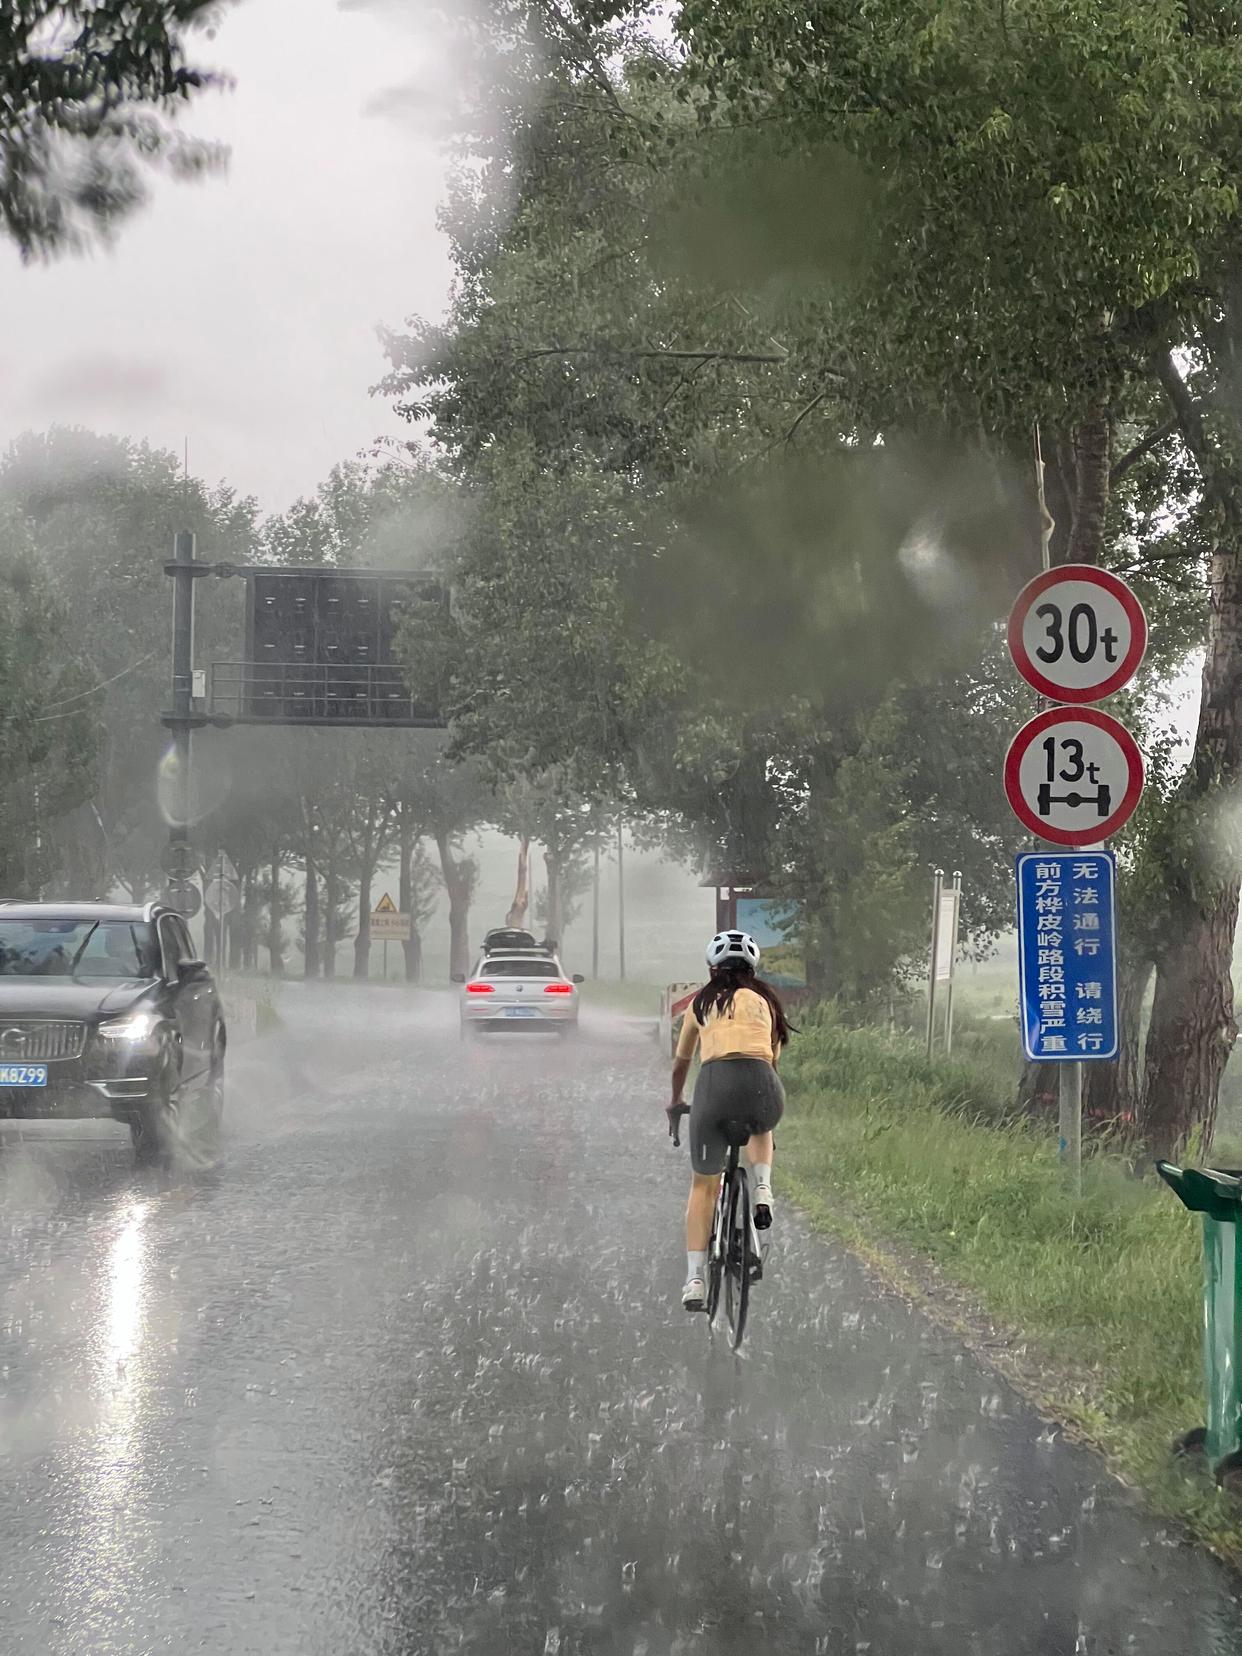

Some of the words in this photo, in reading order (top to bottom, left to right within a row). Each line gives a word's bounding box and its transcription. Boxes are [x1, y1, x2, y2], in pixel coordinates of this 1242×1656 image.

[1036, 603, 1118, 664] 30t
[1043, 737, 1100, 784] 13t
[1072, 863, 1100, 956] 无法通行
[1035, 862, 1067, 1052] 前方桦皮岭路段积雪严重
[1075, 981, 1103, 1050] 请绕行
